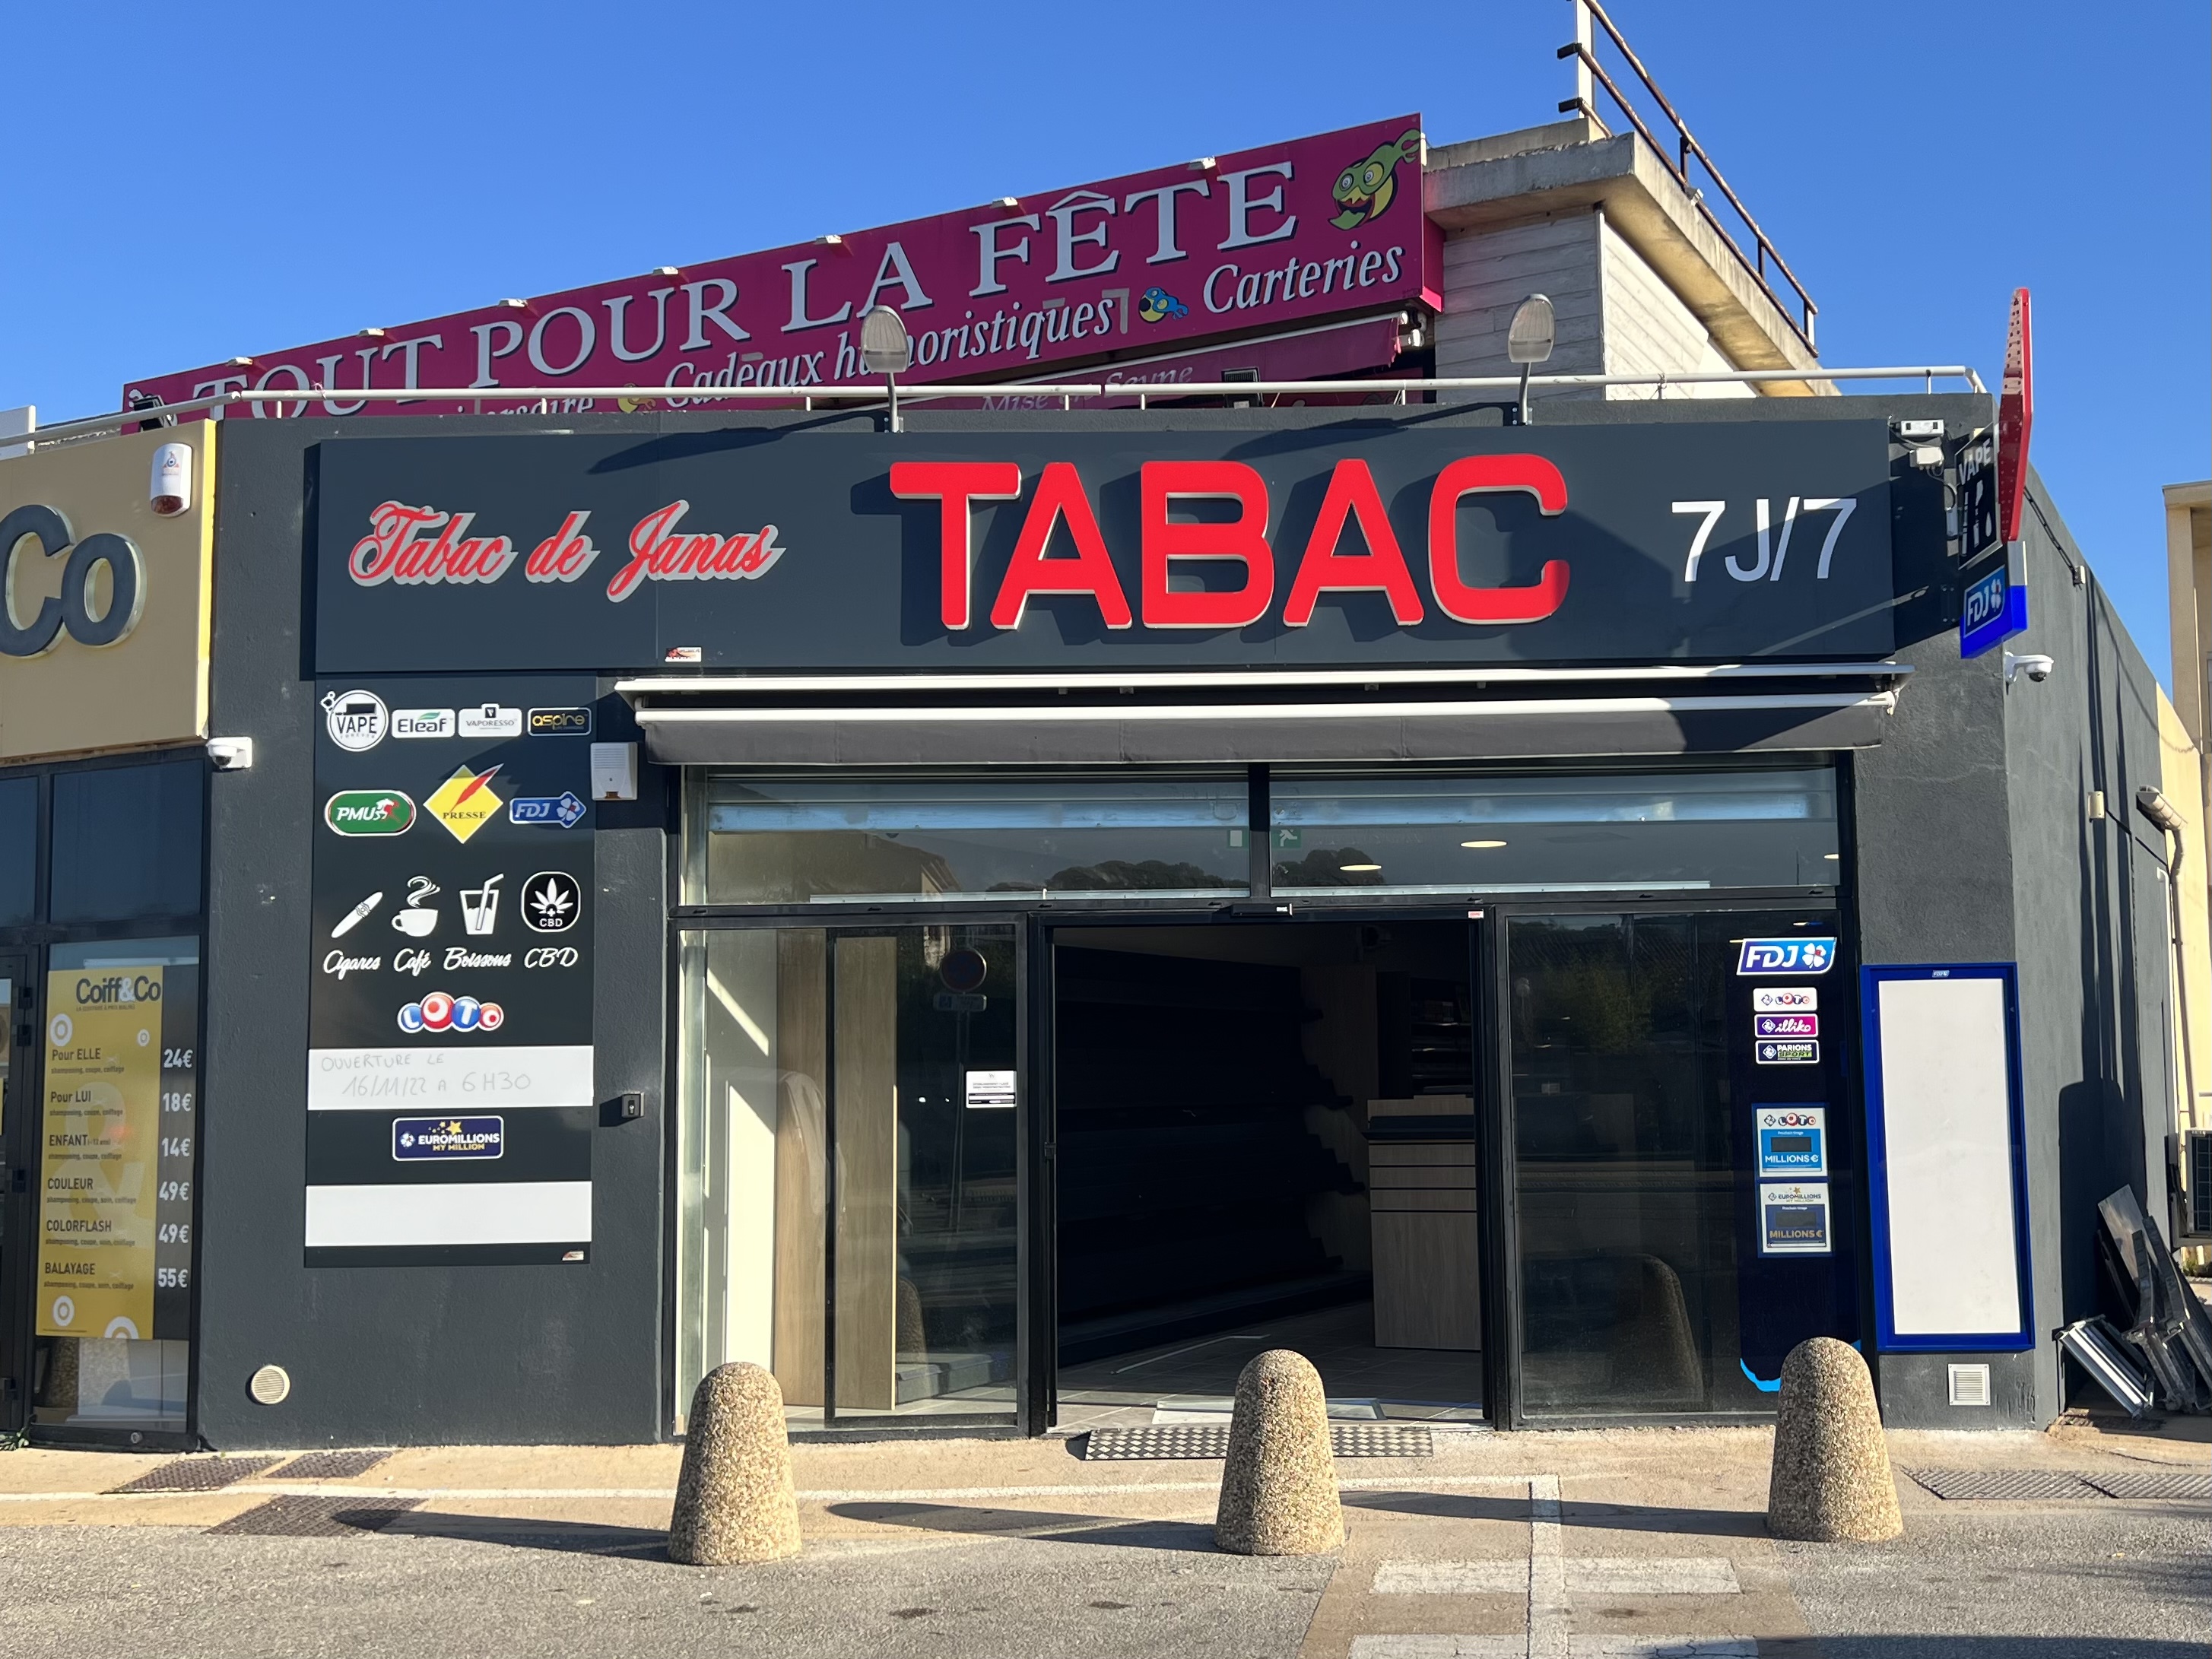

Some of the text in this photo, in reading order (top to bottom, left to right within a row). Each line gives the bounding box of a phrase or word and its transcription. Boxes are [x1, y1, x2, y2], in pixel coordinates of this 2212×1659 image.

[193, 161, 1297, 420] TOUT POUR LA FÊTE
[665, 240, 1404, 408] Cadeaux horistiques Carteries
[1959, 438, 1991, 485] VAPE
[349, 500, 786, 602] Tabac de Janas
[890, 453, 1570, 630] TABAC
[0, 504, 148, 658] Co
[1967, 585, 1990, 626] FDJ
[337, 716, 378, 734] VAPE
[398, 718, 447, 732] Eleaf
[532, 713, 585, 730] aspire
[337, 807, 378, 821] PMU
[443, 810, 487, 820] PRESSE
[515, 802, 551, 818] FDJ
[539, 918, 563, 928] CBD
[323, 947, 579, 980] Cigares Café Boissons CBD
[1746, 945, 1800, 969] FDJ
[76, 976, 161, 1004] Coiff&Co
[1775, 992, 1810, 1005] LOTO
[399, 992, 503, 1032] LOTO
[1774, 1018, 1811, 1033] illiko
[52, 1048, 193, 1068] Pour ELLE 24€
[322, 1054, 445, 1072] OUVERTURE LE
[342, 1075, 427, 1097] 16/11/22
[50, 1090, 192, 1112] Pour LUI 18€
[1778, 1112, 1817, 1127] LOTO
[49, 1134, 88, 1147] ENFANT
[161, 1137, 190, 1157] 14€
[417, 1133, 500, 1145] EUROMILLIONS
[47, 1178, 189, 1201] COULEUR 49€
[46, 1220, 189, 1243] COLORFLASH 49€
[45, 1262, 188, 1288] BALAYAGE 55€
